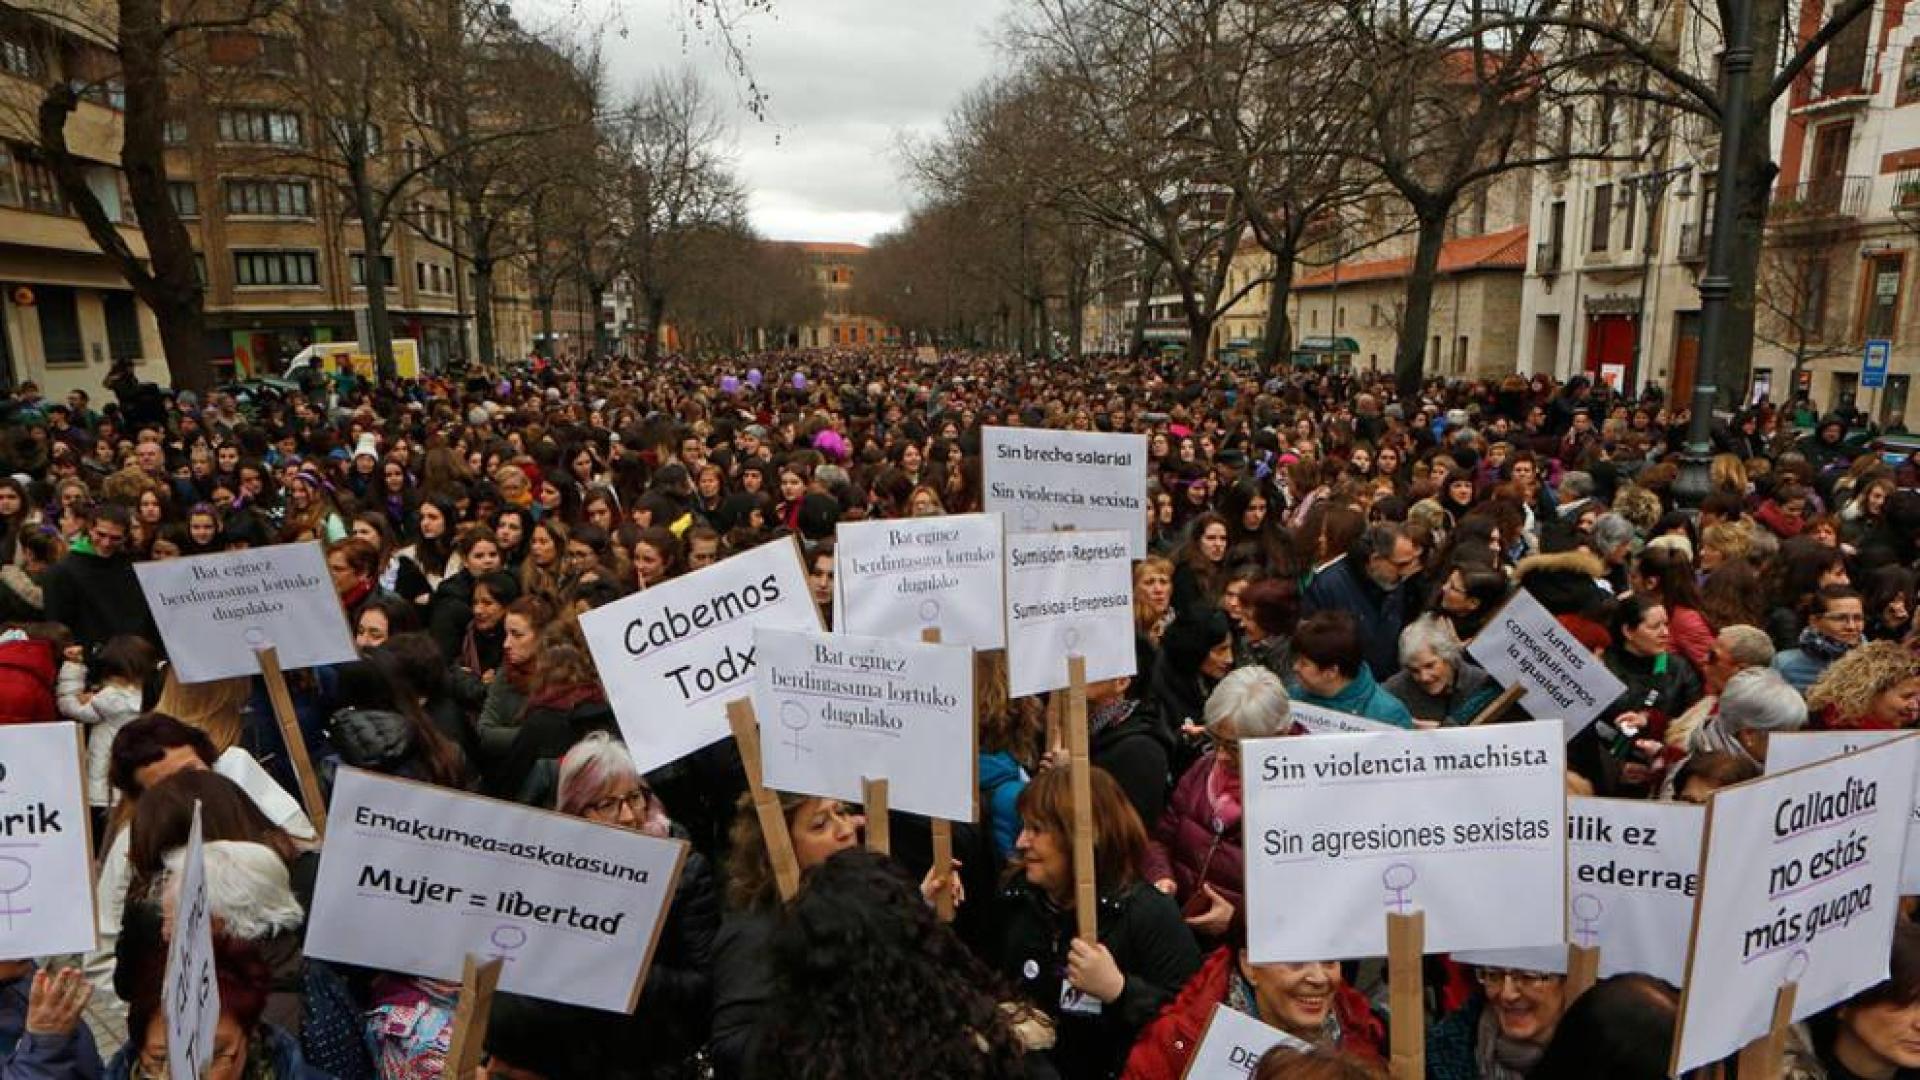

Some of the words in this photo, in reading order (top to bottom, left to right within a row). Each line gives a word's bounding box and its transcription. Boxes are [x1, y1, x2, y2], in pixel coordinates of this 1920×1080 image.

[997, 444, 1021, 459] Sin
[1024, 445, 1073, 464] brecha
[1076, 451, 1132, 467] salarial
[991, 482, 1015, 499] Sin
[1018, 484, 1085, 506] violencia
[1089, 490, 1140, 509] sexista
[890, 530, 913, 547] Bat
[852, 552, 943, 576] berdintasuna
[946, 546, 996, 565] lortuko
[159, 582, 258, 606] berdintasuna
[897, 575, 959, 594] dugulako
[212, 600, 284, 622] dugulako
[623, 573, 780, 655] Cabemos
[815, 644, 843, 665] Bat
[849, 651, 907, 673] eginez
[1506, 643, 1520, 660] la
[1506, 618, 1597, 707] conseguiremos
[1543, 626, 1586, 670] Juntas
[664, 645, 757, 699] Todx
[771, 667, 883, 698] berdintasuna
[887, 681, 957, 708] lortuko
[1519, 657, 1575, 709] igualdad
[821, 702, 903, 730] dugulako
[1262, 755, 1306, 782] Sin
[1314, 749, 1427, 779] violencia
[1434, 743, 1548, 770] machista
[0, 802, 62, 834] rik
[1774, 775, 1878, 837] Calladita
[354, 805, 649, 884] Emakumea=askatasuna
[1264, 830, 1303, 856] Sin
[1312, 822, 1446, 858] agresiones
[1454, 817, 1550, 844] sexistas
[1623, 826, 1657, 846] ez
[1769, 862, 1802, 895] no
[1809, 830, 1868, 880] estás
[357, 865, 463, 905] Mujer
[496, 890, 625, 936] libertad
[1743, 908, 1801, 957] más
[1805, 883, 1873, 942] guapa
